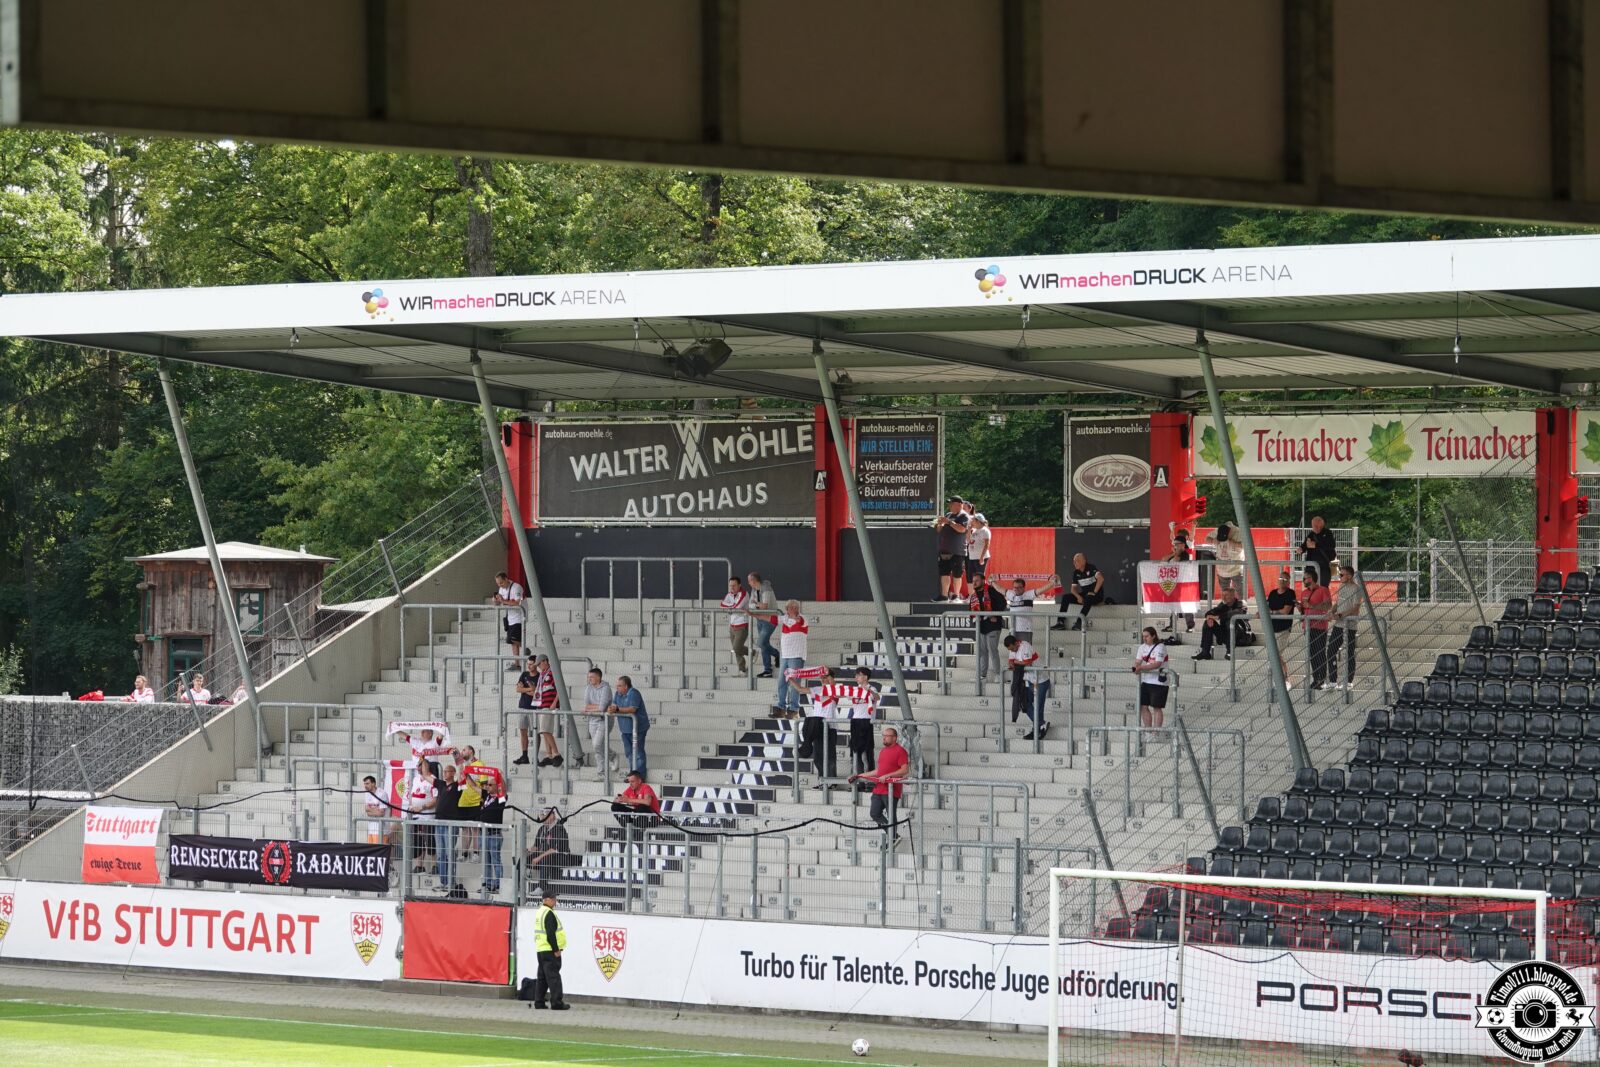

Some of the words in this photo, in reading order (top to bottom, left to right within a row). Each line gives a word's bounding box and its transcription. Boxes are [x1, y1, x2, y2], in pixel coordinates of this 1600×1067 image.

[1019, 267, 1207, 289] WIRmachenDRUCK
[1212, 264, 1293, 283] ARENA
[399, 291, 557, 311] WIRmachenDRUCK
[560, 289, 627, 305] ARENA
[544, 428, 613, 439] autohaus-moehle.de
[861, 423, 935, 433] autohaus-moehle.de
[1076, 423, 1151, 435] autohaus-moehle.d
[712, 425, 813, 464] MÖHLE
[860, 441, 877, 453] WIR
[879, 440, 914, 453] STELLEN
[1252, 428, 1358, 463] Teinacher
[1420, 426, 1535, 461] Teinacher
[569, 444, 670, 481] WALTER
[865, 460, 933, 471] Verkaufsberater
[865, 474, 927, 484] Servicemeister
[1094, 463, 1134, 488] Ford
[1154, 467, 1168, 487] A
[624, 482, 769, 518] AUTOHAUS
[864, 487, 920, 497] Bürokauffrau
[90, 857, 113, 872] ewige
[114, 857, 142, 870] Treue
[171, 845, 260, 871] REMSECKER
[296, 852, 387, 877] RABAUKEN
[43, 899, 102, 942] VfB
[114, 904, 320, 955] STUTTGART
[741, 951, 794, 979] Turbo
[800, 954, 828, 981] für
[832, 956, 909, 986] Talente.
[914, 961, 996, 991] Porsche
